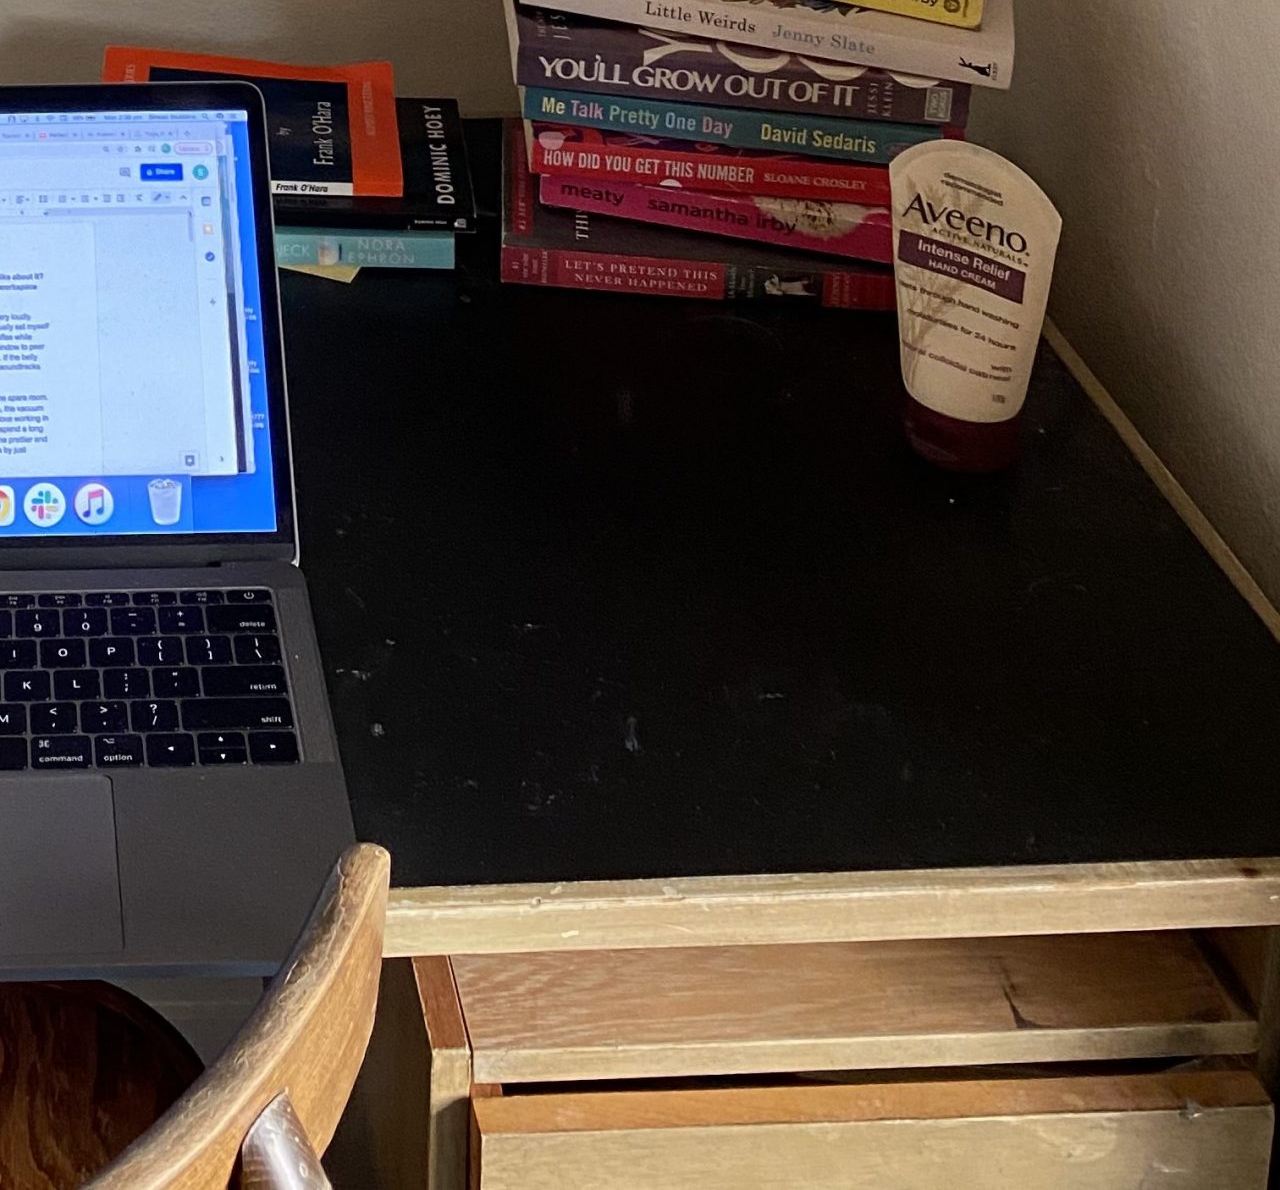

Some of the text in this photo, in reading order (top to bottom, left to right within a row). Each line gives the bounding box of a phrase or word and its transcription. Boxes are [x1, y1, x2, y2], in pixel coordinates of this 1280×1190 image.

[645, 0, 876, 55] Little Weirds Jenny Slate
[538, 53, 861, 108] YOU'LL GROW OUT OF IT
[312, 101, 335, 166] Frank O'Hara
[422, 105, 446, 139] HOEY
[541, 96, 566, 115] Me
[570, 99, 605, 120] Talk
[608, 105, 661, 129] Pretty
[664, 112, 697, 130] One
[701, 115, 734, 140] Day
[760, 123, 807, 146] David
[811, 132, 877, 155] Sedaris
[428, 143, 456, 205] DOMINIC
[543, 149, 868, 191] HOW DID YOU GET THIS NUMBER SLOANE CROSLEY
[275, 183, 329, 194] Frank O'Hara
[560, 183, 798, 236] meaty samantha irby
[357, 238, 406, 252] NORA
[932, 227, 968, 244] ACTIVE
[347, 251, 416, 265] EPHRON
[564, 259, 718, 281] LET'S PRETEND THIS
[917, 238, 1012, 281] Intense Relief
[928, 259, 997, 290] HAND CREAM
[573, 272, 623, 286] NEVER
[627, 274, 709, 293] HAPPENED
[981, 309, 1020, 330] washing
